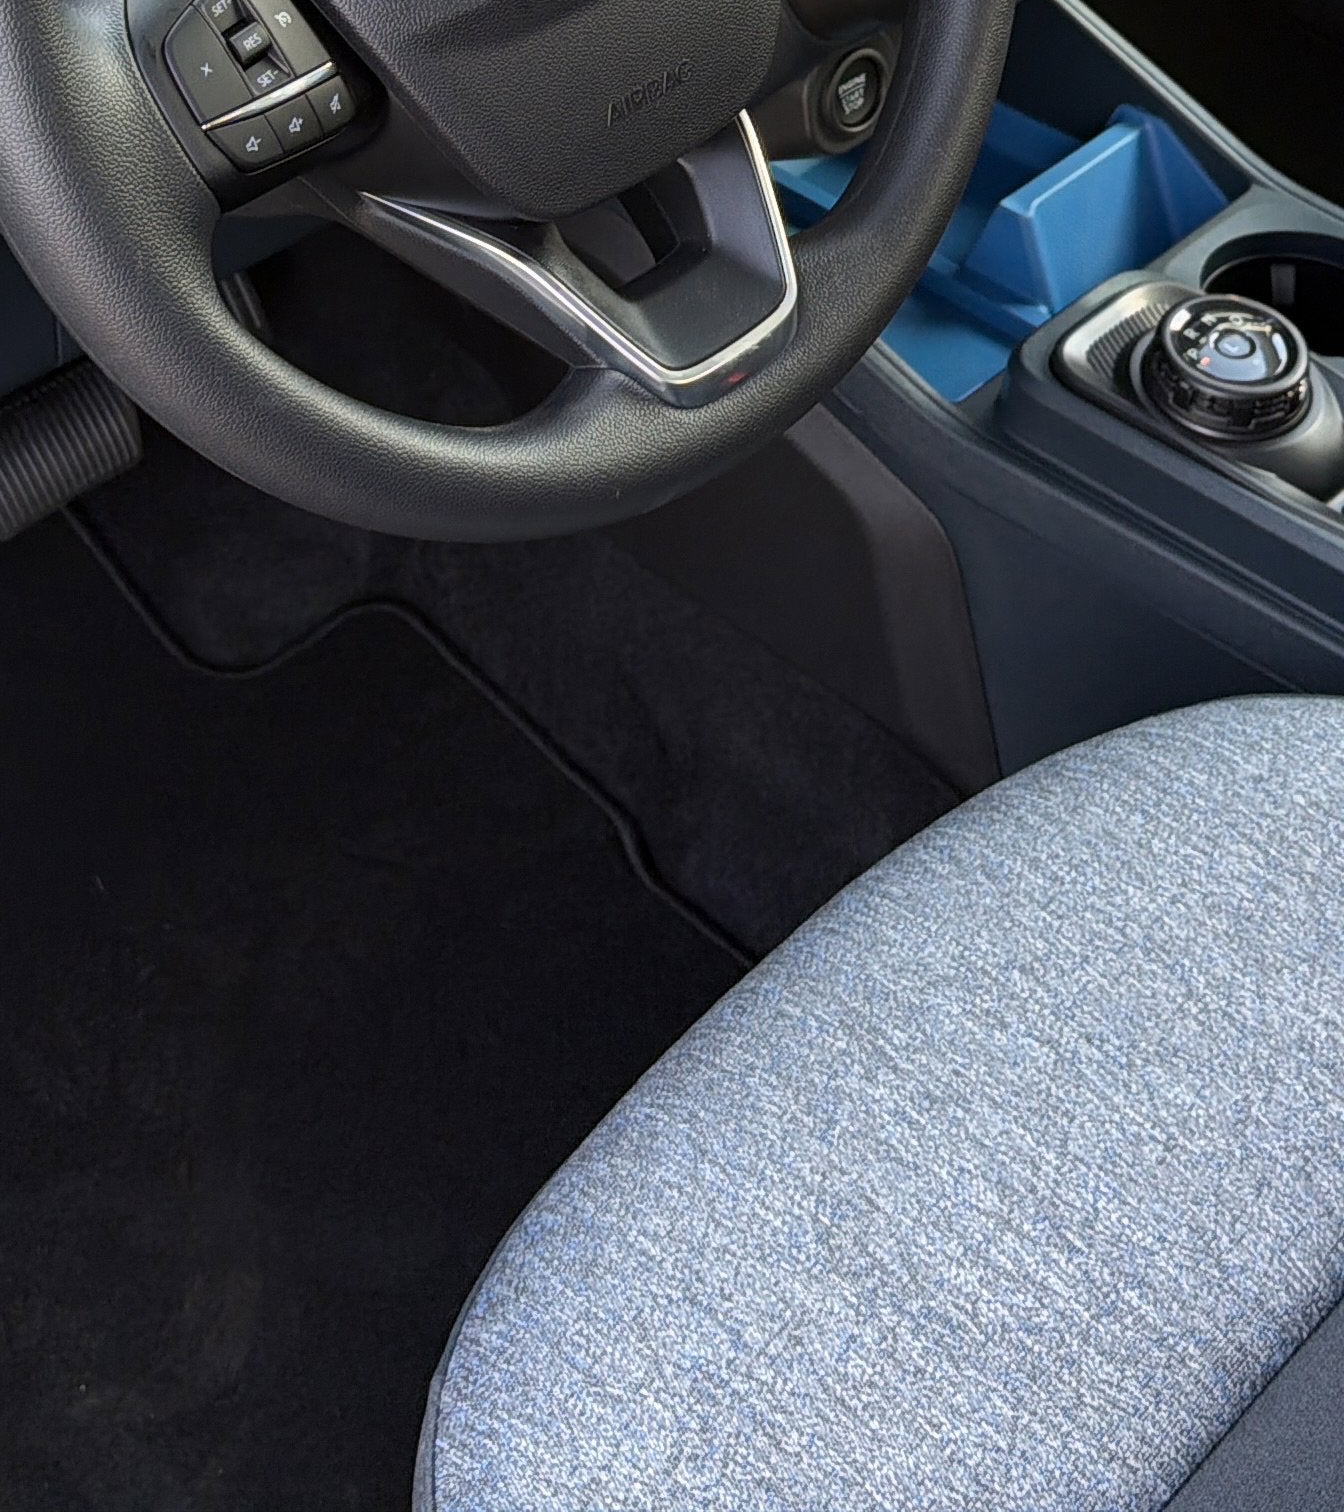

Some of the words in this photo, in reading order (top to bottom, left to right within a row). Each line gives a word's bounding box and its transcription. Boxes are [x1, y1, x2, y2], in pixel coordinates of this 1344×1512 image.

[242, 32, 263, 51] RES
[256, 69, 279, 88] SET-
[607, 58, 693, 128] AIRBAG
